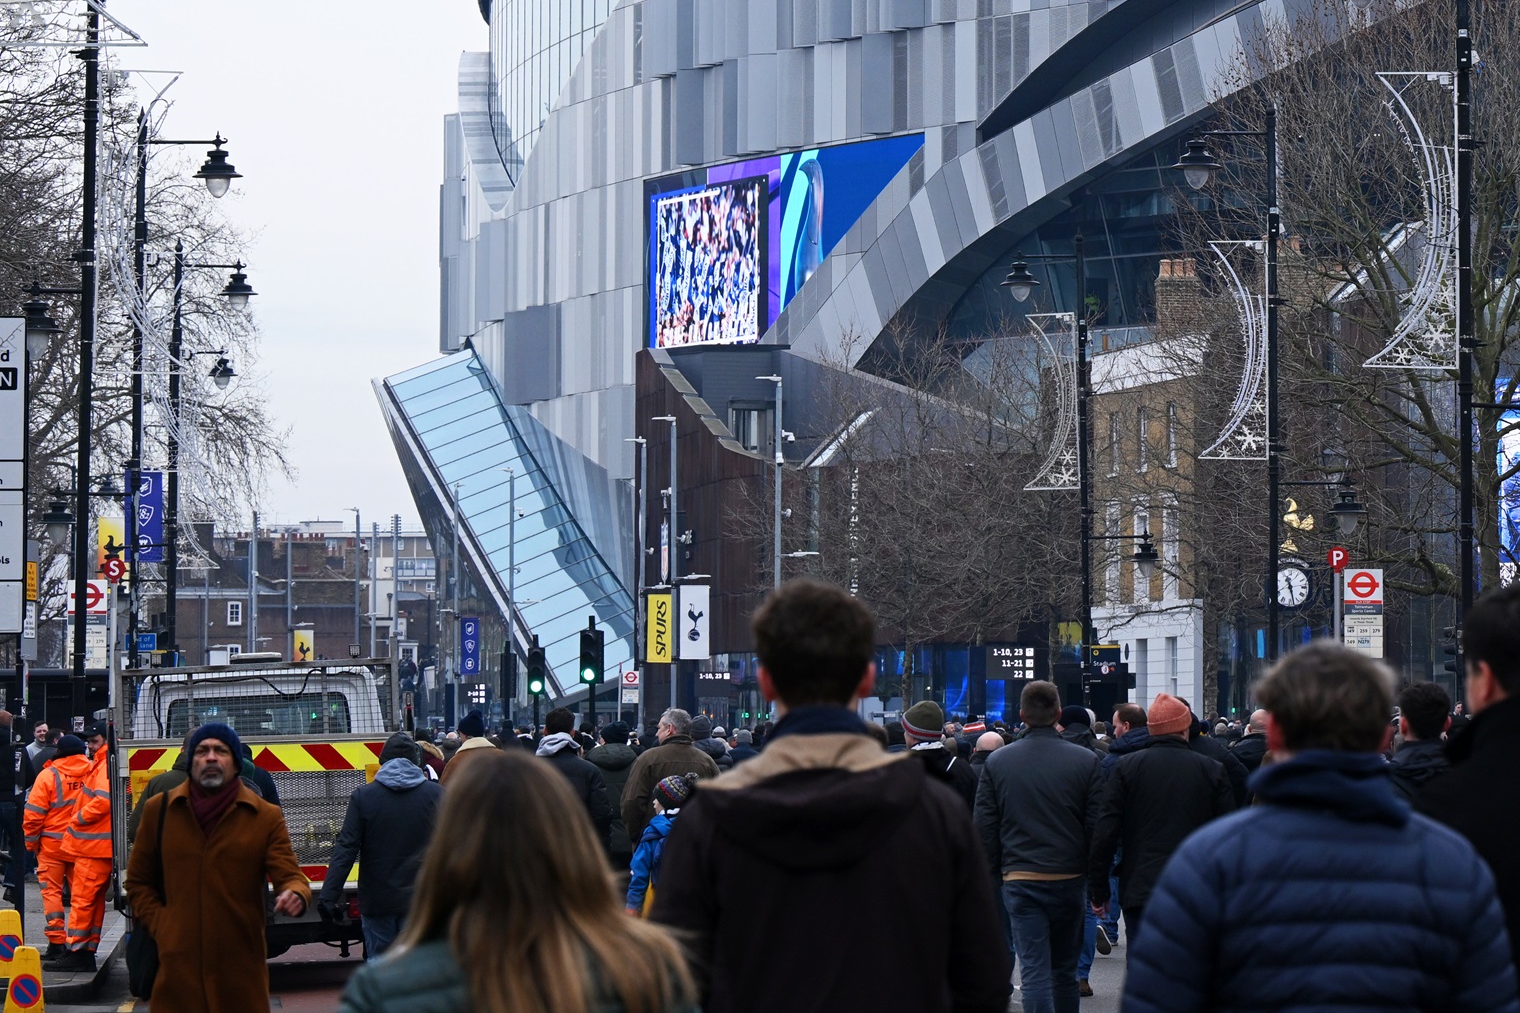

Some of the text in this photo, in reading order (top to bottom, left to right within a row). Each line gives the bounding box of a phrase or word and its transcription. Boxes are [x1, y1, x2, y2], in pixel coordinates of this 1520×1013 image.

[1332, 550, 1344, 566] P
[109, 560, 120, 576] S
[656, 600, 667, 658] SPURS
[993, 648, 1024, 657] 1-10, 23
[1001, 659, 1023, 667] 11-21
